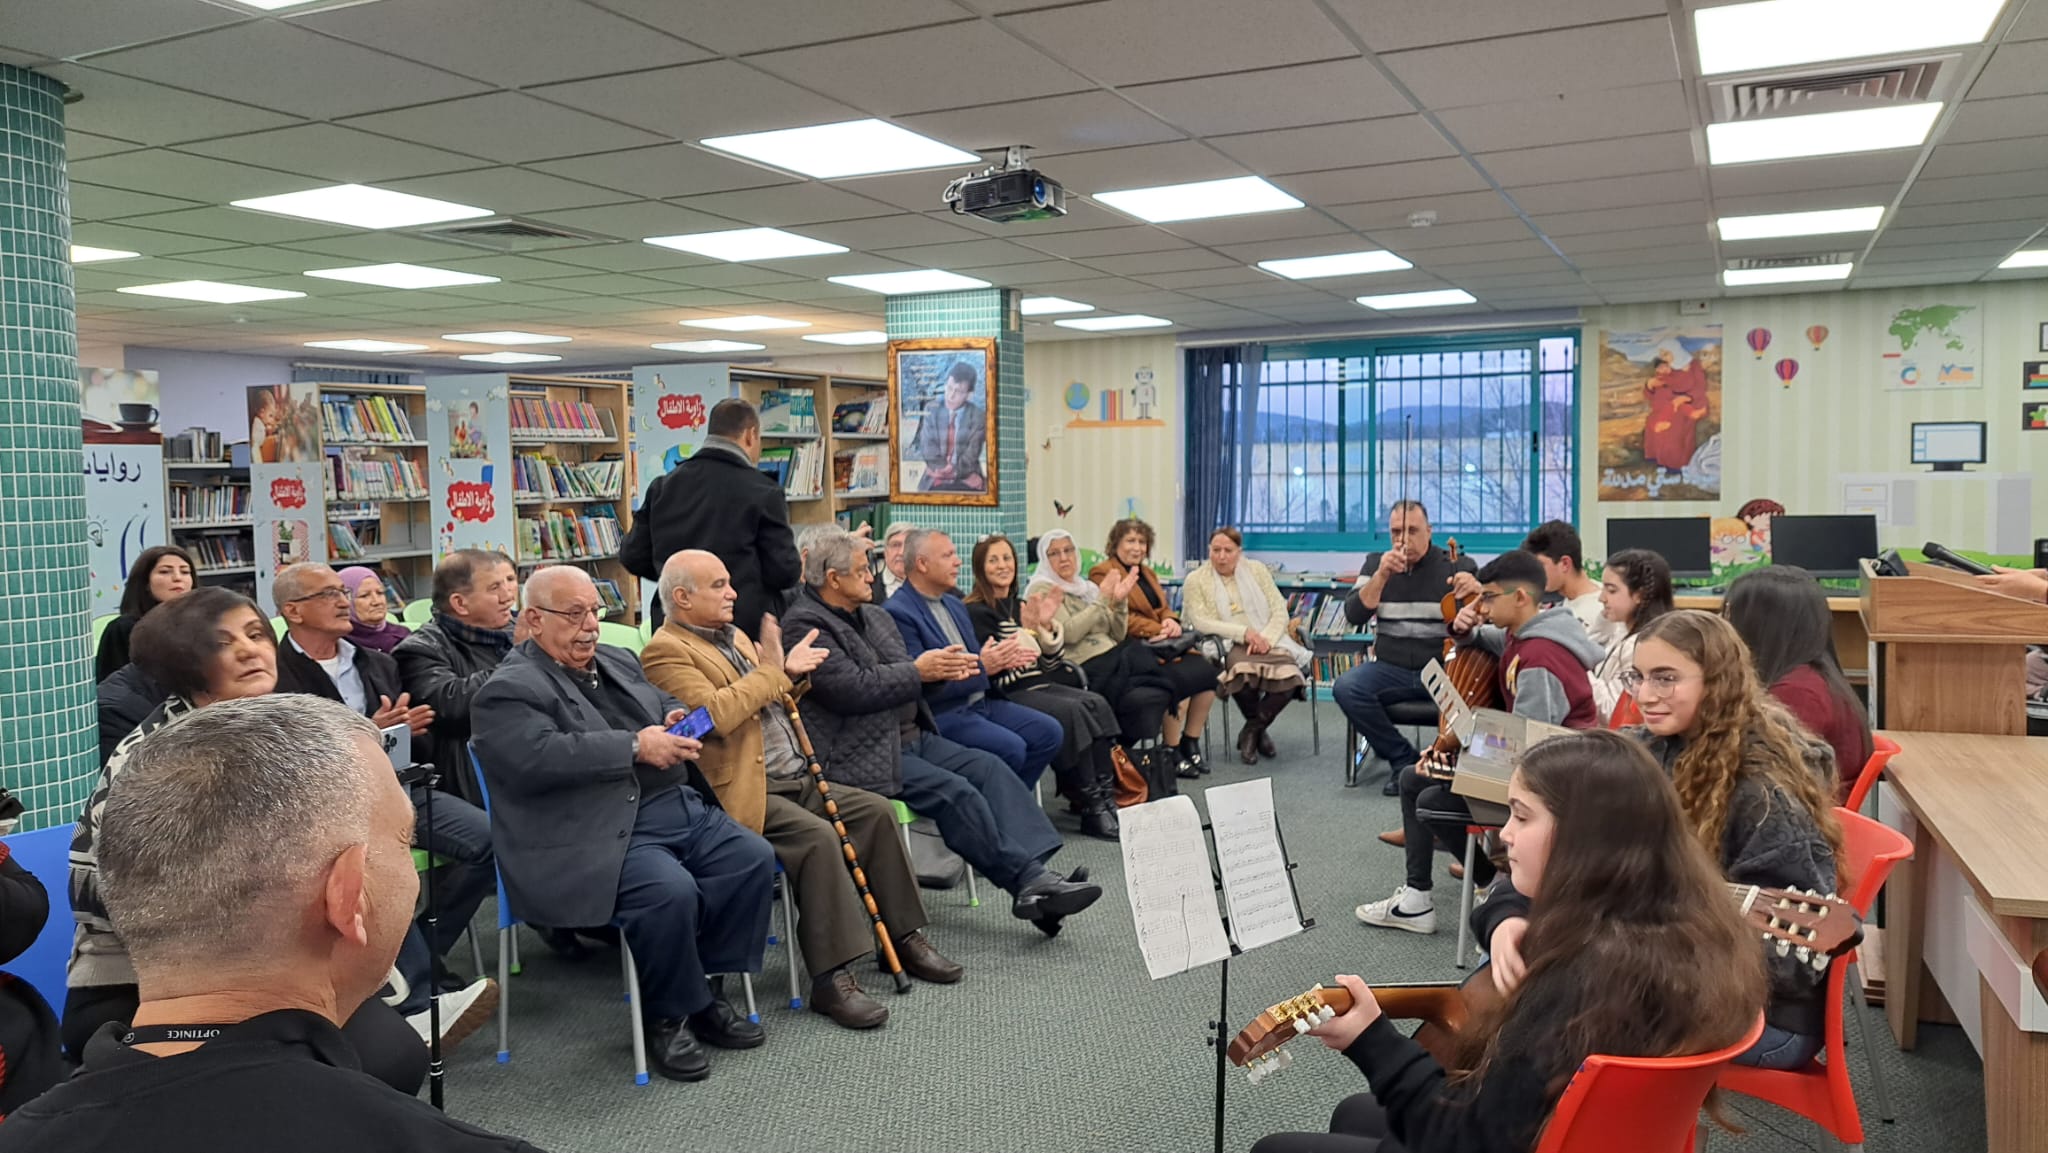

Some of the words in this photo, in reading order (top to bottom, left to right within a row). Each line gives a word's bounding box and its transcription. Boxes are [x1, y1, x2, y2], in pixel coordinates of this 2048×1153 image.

[686, 398, 702, 420] زاوية
[83, 451, 141, 482] روايا
[475, 489, 491, 514] زاوية
[167, 1029, 220, 1039] OPTINICE
